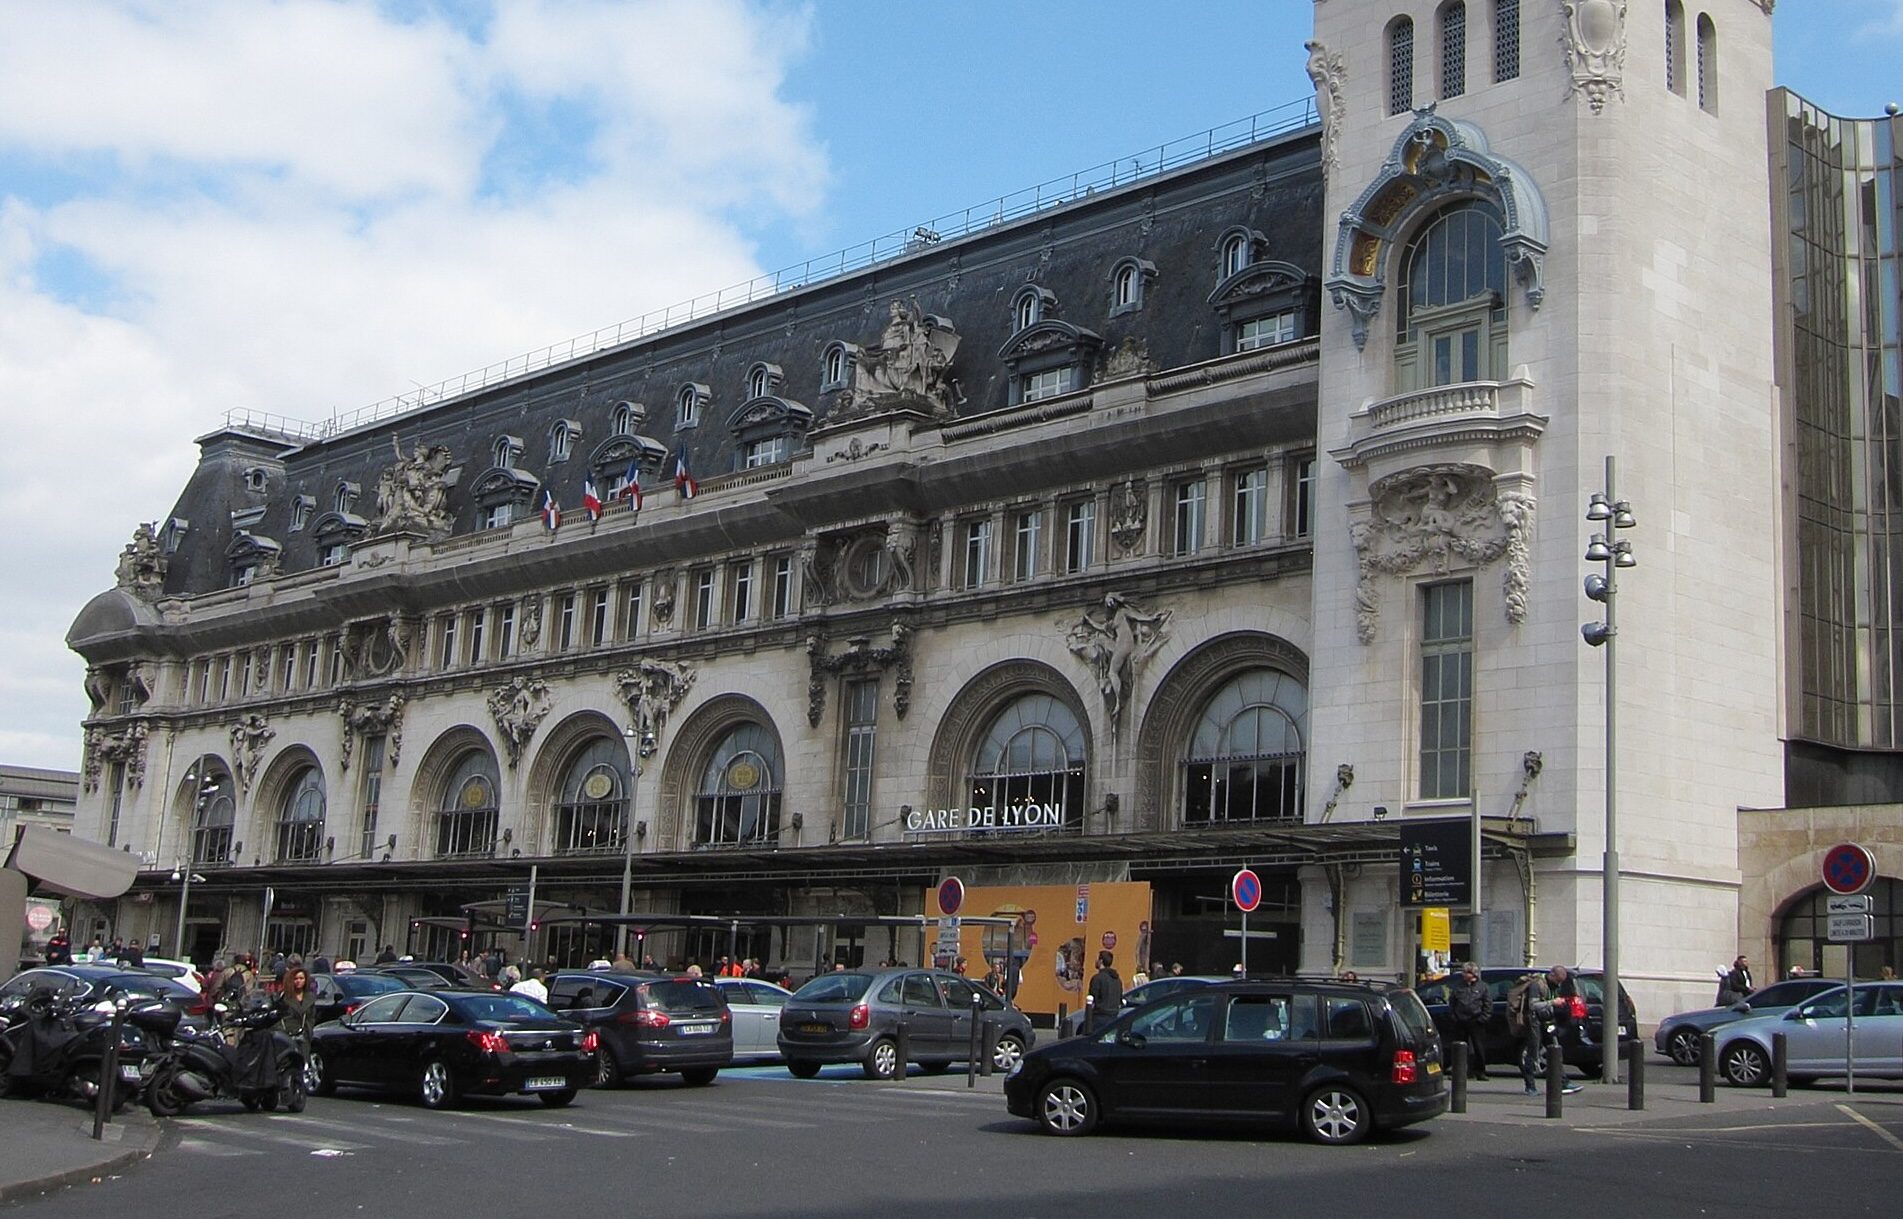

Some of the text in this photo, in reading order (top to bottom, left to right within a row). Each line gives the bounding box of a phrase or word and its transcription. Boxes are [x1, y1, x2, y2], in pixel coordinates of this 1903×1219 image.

[907, 802, 1060, 831] GARE DE LYON
